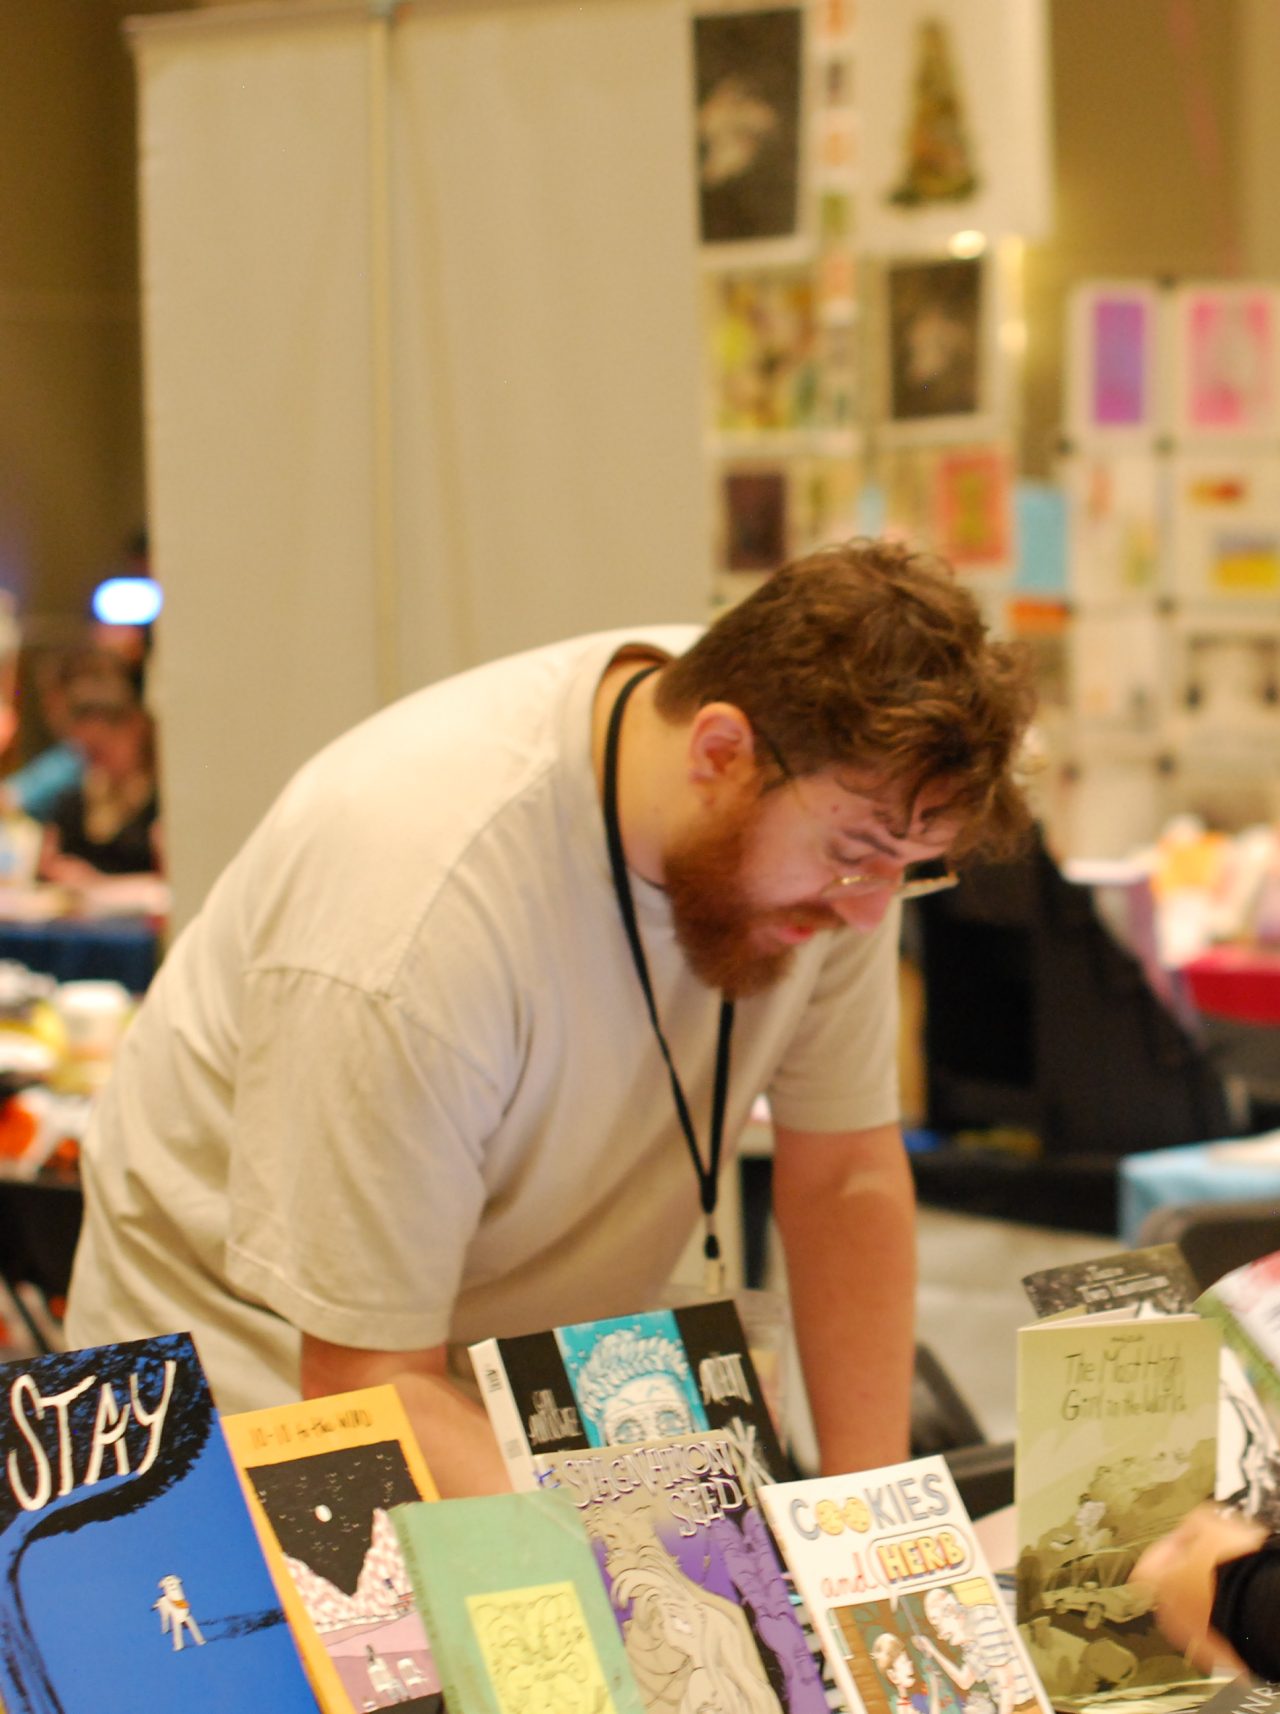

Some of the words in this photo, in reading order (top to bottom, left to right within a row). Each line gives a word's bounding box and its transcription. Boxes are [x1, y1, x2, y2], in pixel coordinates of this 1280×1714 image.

[1065, 1352, 1096, 1385] The
[7, 1359, 177, 1511] STAY
[563, 1440, 737, 1509] STAGNATION
[669, 1477, 745, 1537] SEED
[789, 1473, 951, 1540] COOKIES
[821, 1552, 878, 1598] and
[876, 1531, 967, 1584] HERB
